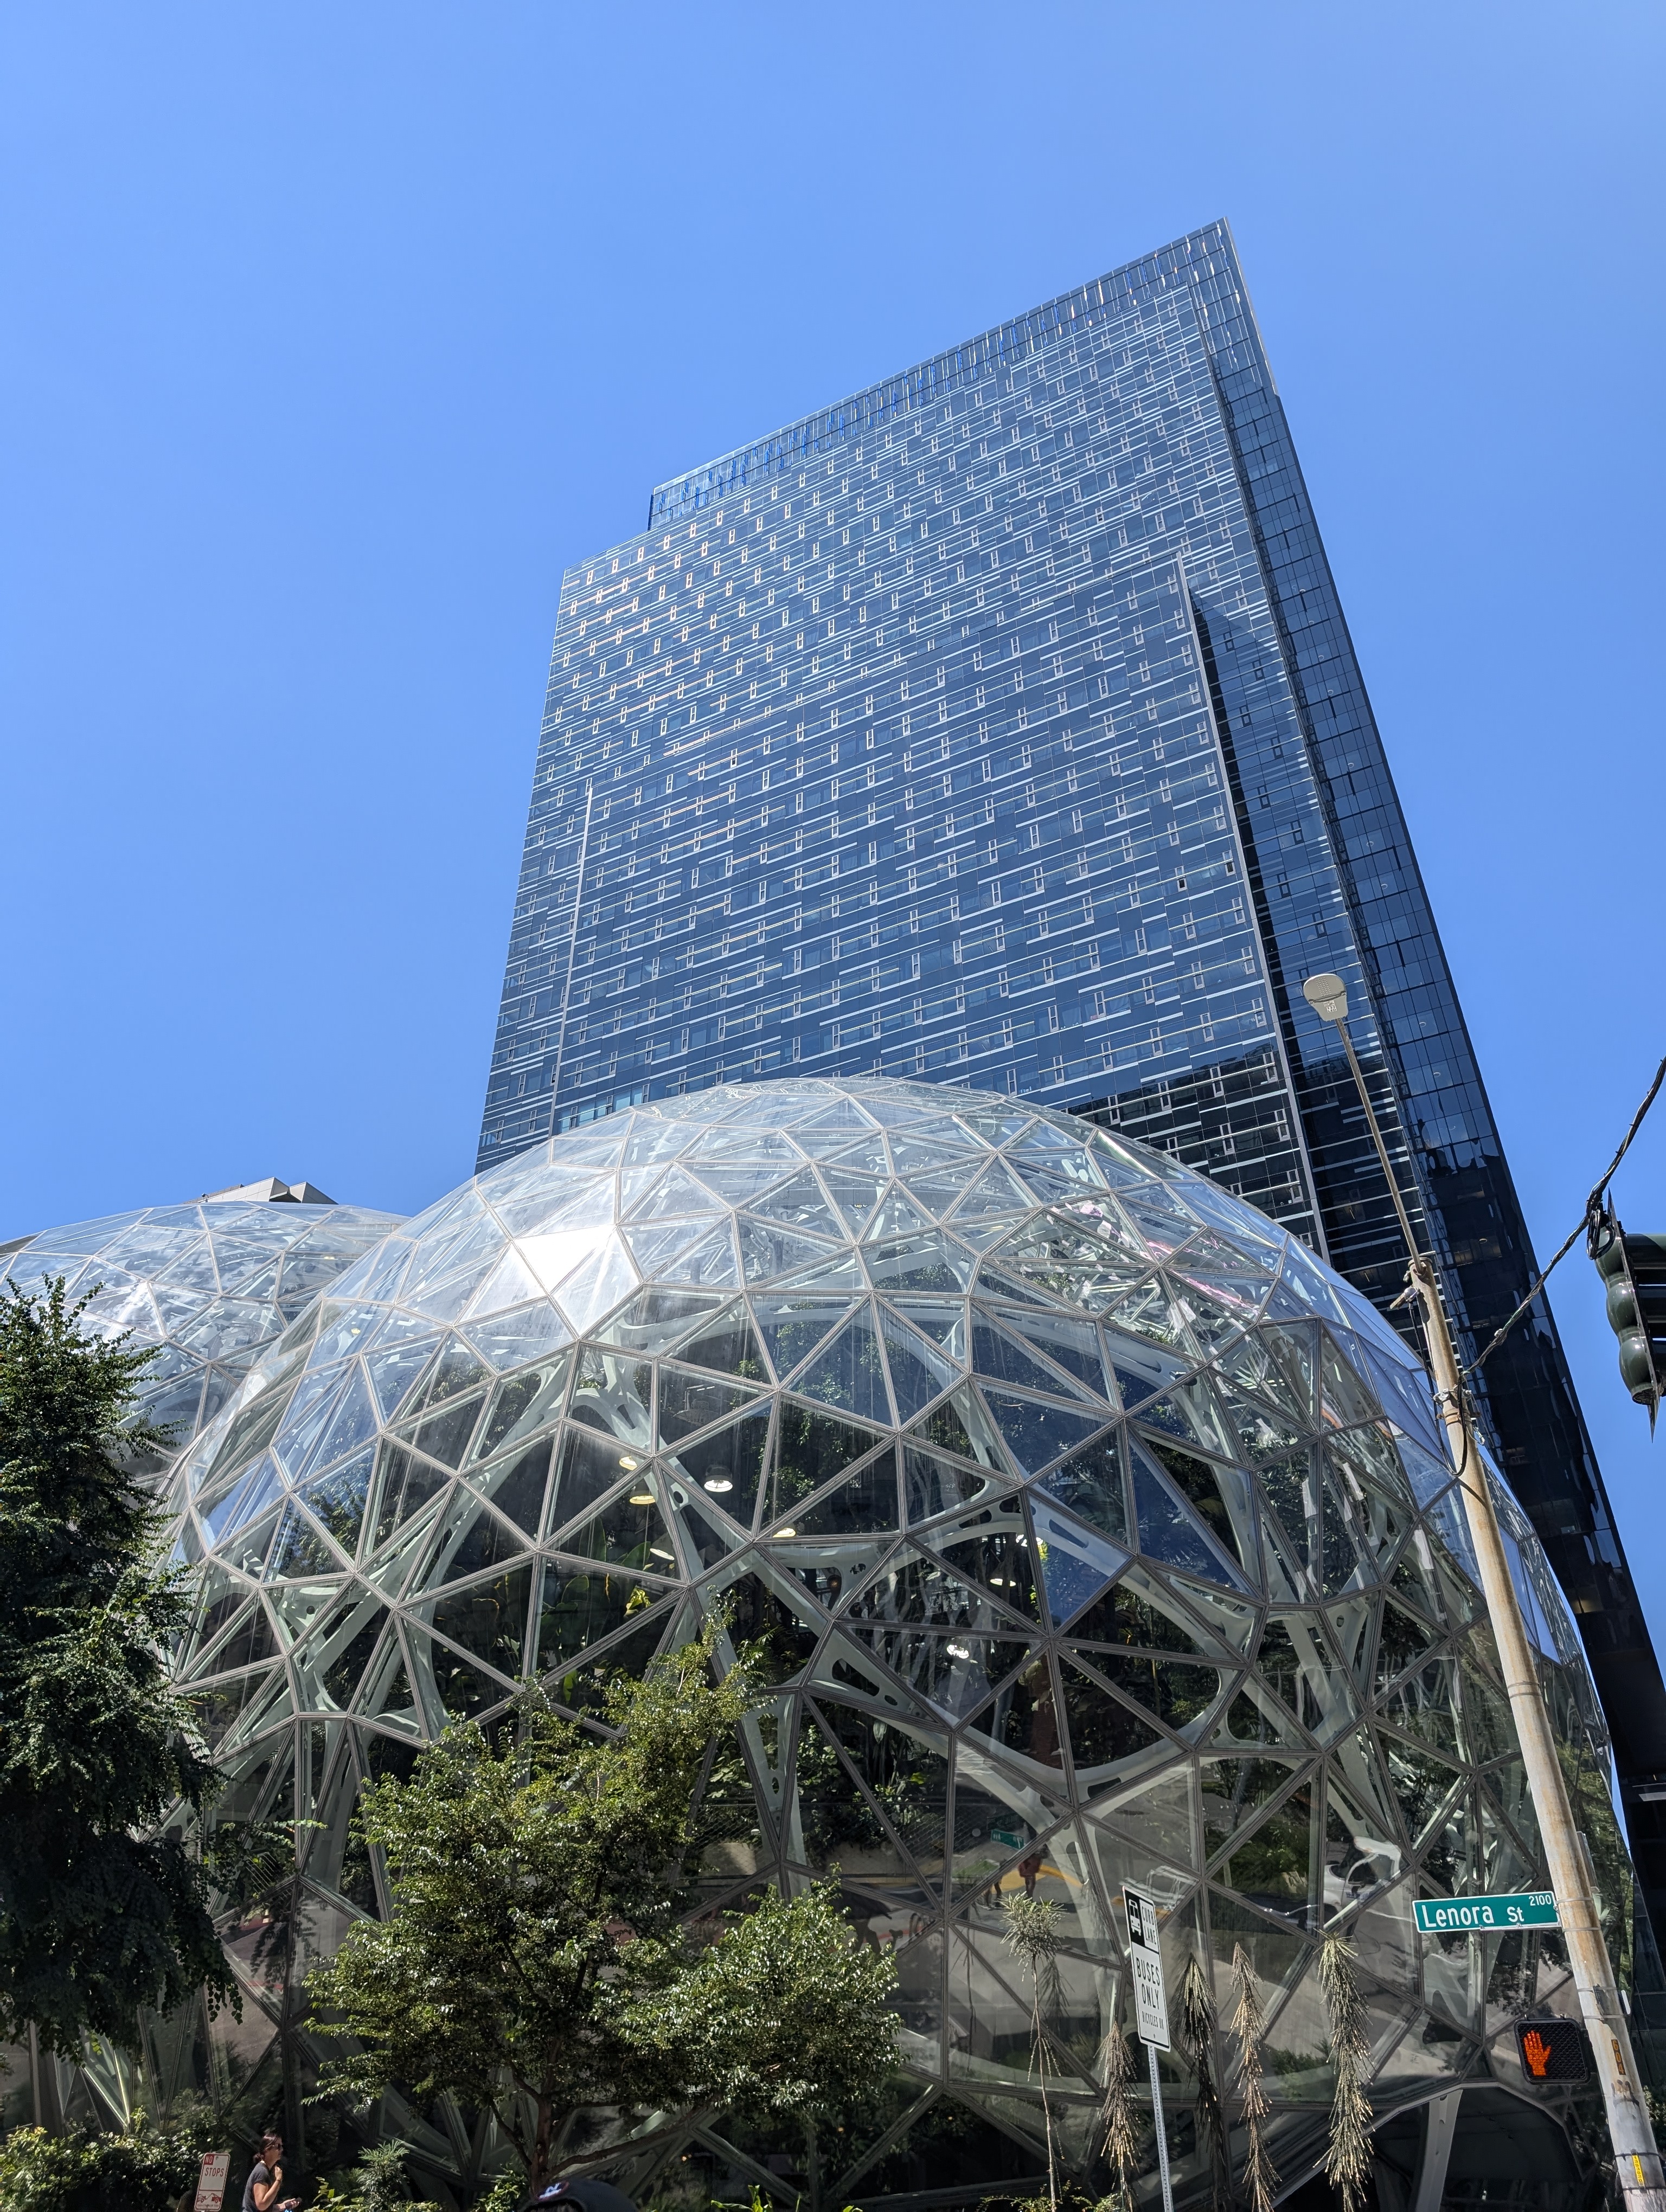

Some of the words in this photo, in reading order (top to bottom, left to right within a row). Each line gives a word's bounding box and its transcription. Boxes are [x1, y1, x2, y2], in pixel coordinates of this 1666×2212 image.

[1528, 1894, 1552, 1906] 2100
[1142, 1906, 1154, 1925] CURB
[1421, 1905, 1494, 1928] Lenora
[1507, 1906, 1524, 1922] St
[1144, 1925, 1156, 1945] LANE
[1136, 1957, 1160, 1986] BUSES
[1142, 1983, 1159, 2010] ONLY
[1142, 2010, 1158, 2028] BICYCLES
[1612, 2040, 1624, 2074] 604
[204, 2167, 225, 2177] STOPS
